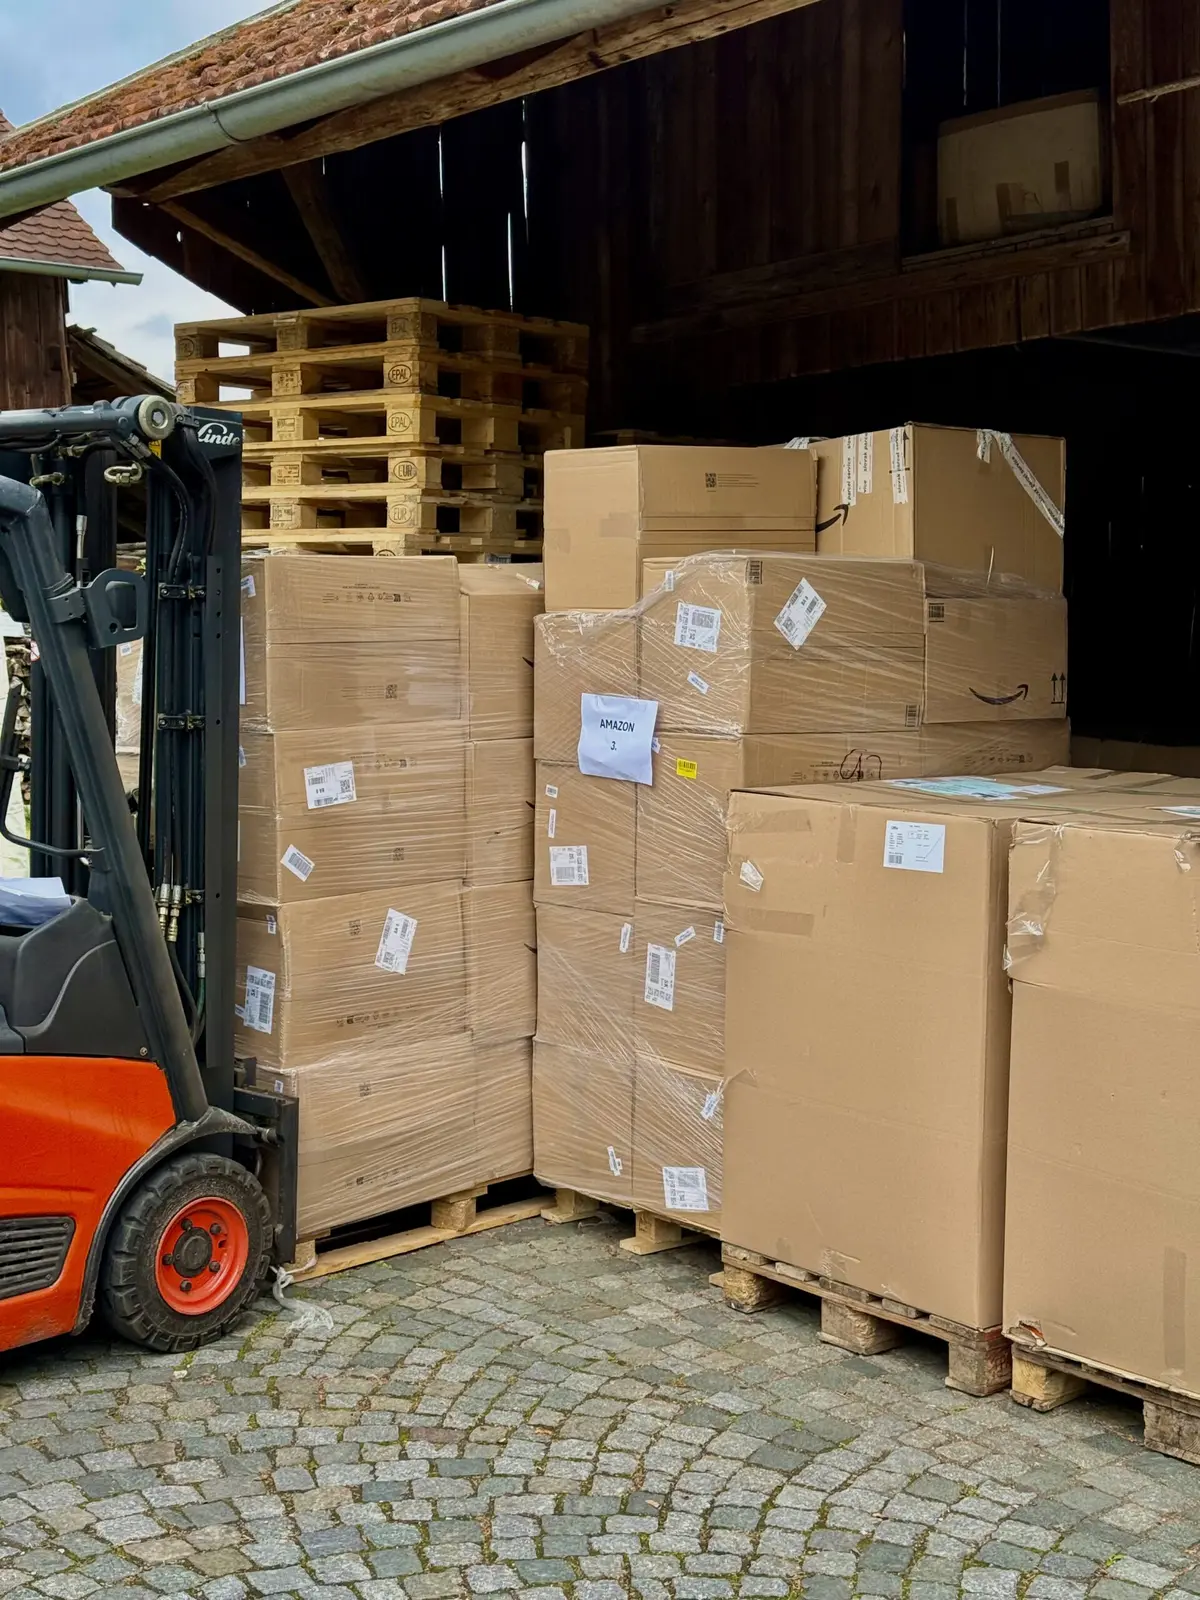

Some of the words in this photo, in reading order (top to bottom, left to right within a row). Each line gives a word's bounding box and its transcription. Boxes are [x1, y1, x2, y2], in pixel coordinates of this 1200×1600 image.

[391, 369, 408, 381] EPAL
[391, 416, 407, 428] EPAL
[197, 422, 241, 446] Linde
[397, 464, 412, 477] EUR
[1011, 455, 1025, 476] service
[1023, 471, 1036, 492] parcel
[393, 507, 407, 521] EUR
[599, 718, 636, 733] AMAZON
[610, 740, 617, 751] 3.
